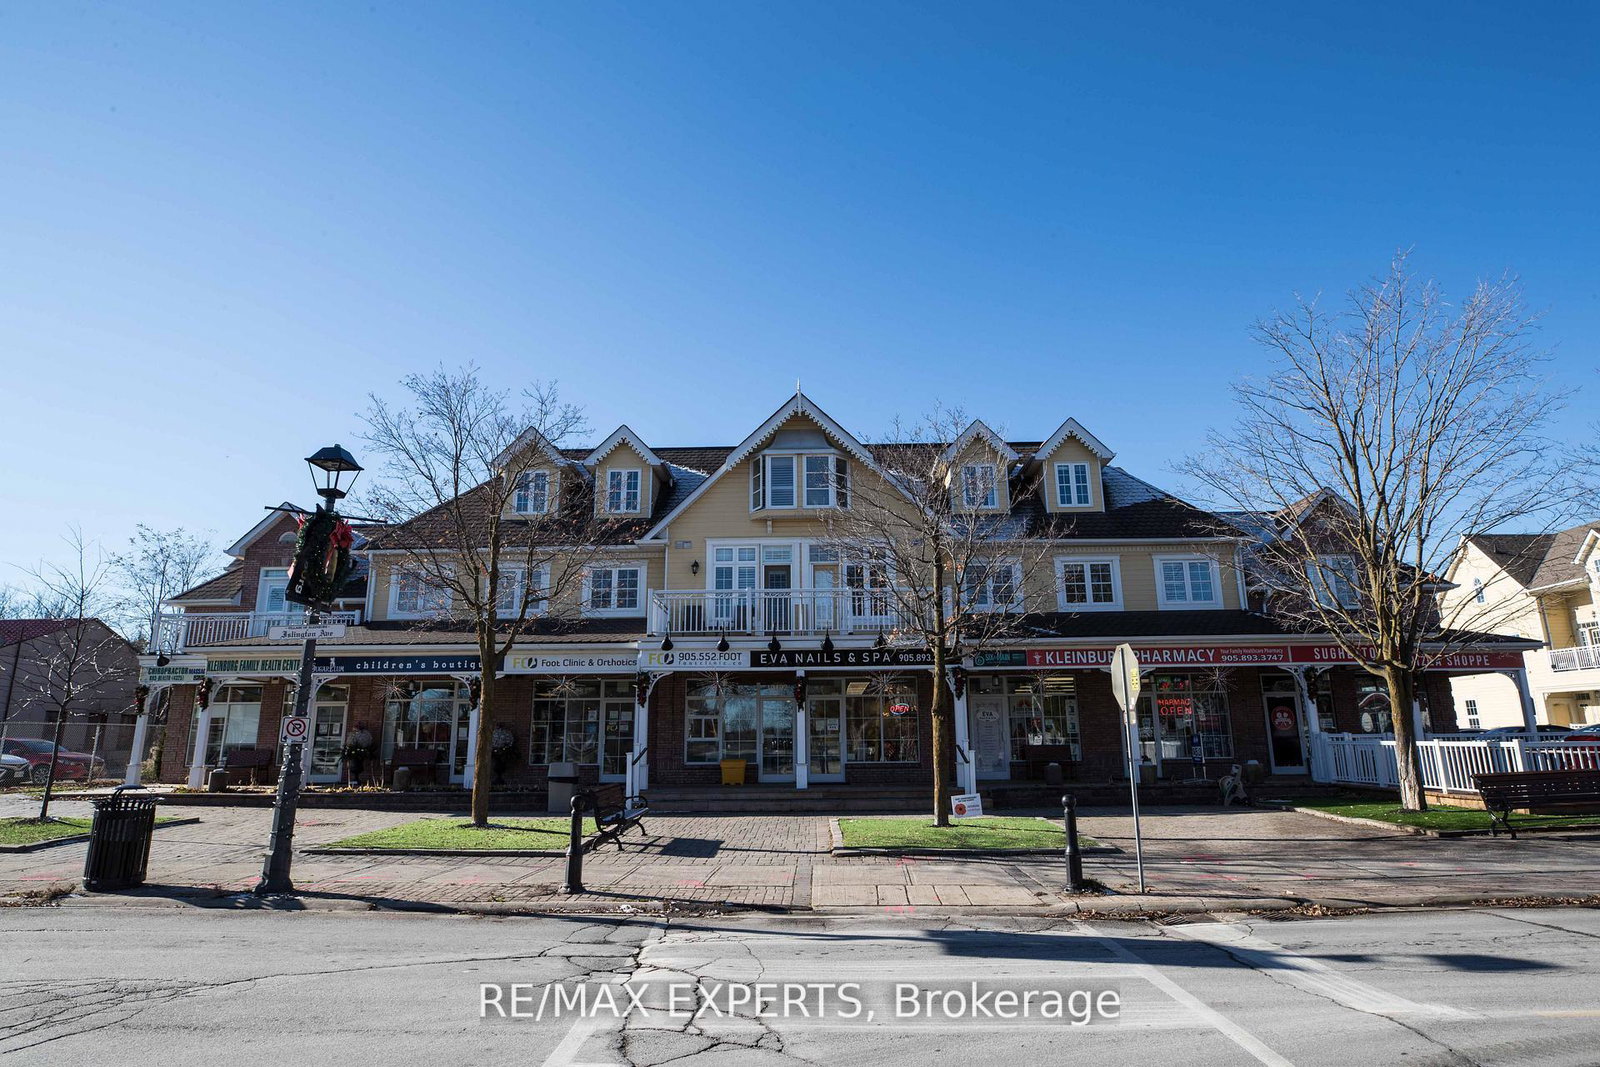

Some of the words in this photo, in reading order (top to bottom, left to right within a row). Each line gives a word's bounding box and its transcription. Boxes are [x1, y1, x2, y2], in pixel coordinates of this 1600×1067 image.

[281, 629, 316, 639] Islington
[679, 652, 742, 661] 905.552.FOOT
[760, 653, 788, 664] EVA
[795, 653, 841, 663] NAILS
[848, 653, 856, 662] &
[862, 652, 891, 662] SPA
[899, 653, 934, 662] 905.893.
[1046, 651, 1115, 664] KLEINBUR
[1447, 655, 1490, 666] SHOPPE
[240, 660, 261, 671] FAMILY
[261, 660, 282, 671] HEALTH
[356, 660, 426, 670] children's
[562, 659, 586, 667] Clinic
[597, 659, 637, 667] Orthotics
